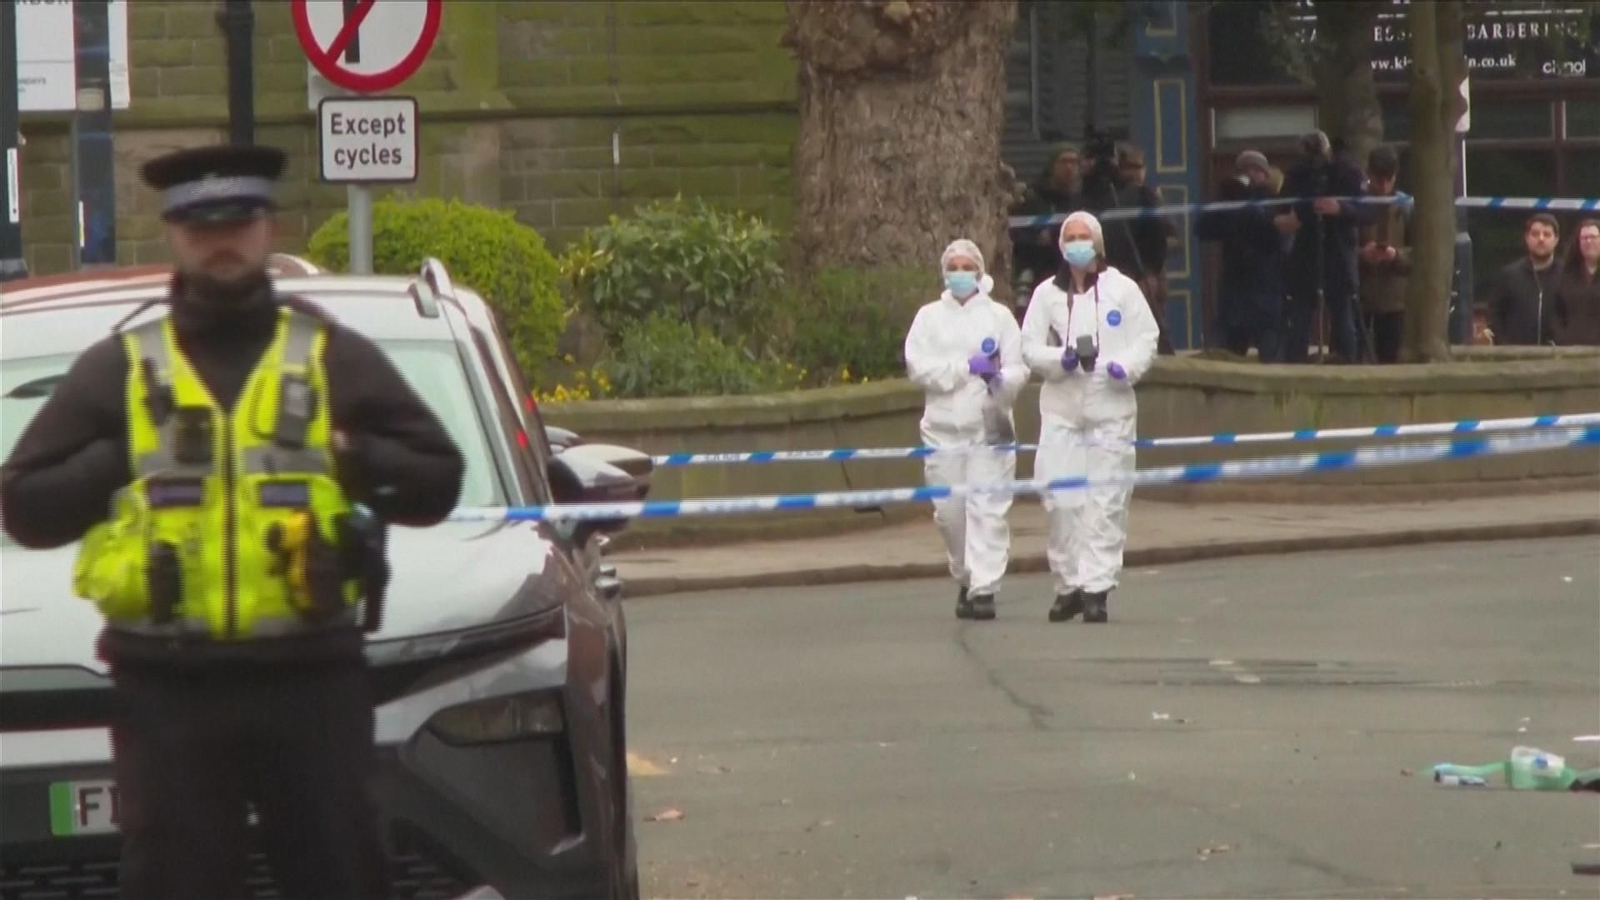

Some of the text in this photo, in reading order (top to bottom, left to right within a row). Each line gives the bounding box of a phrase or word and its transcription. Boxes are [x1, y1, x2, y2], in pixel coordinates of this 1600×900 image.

[1542, 59, 1586, 74] clnol
[331, 112, 406, 138] Except
[334, 142, 402, 169] cycles
